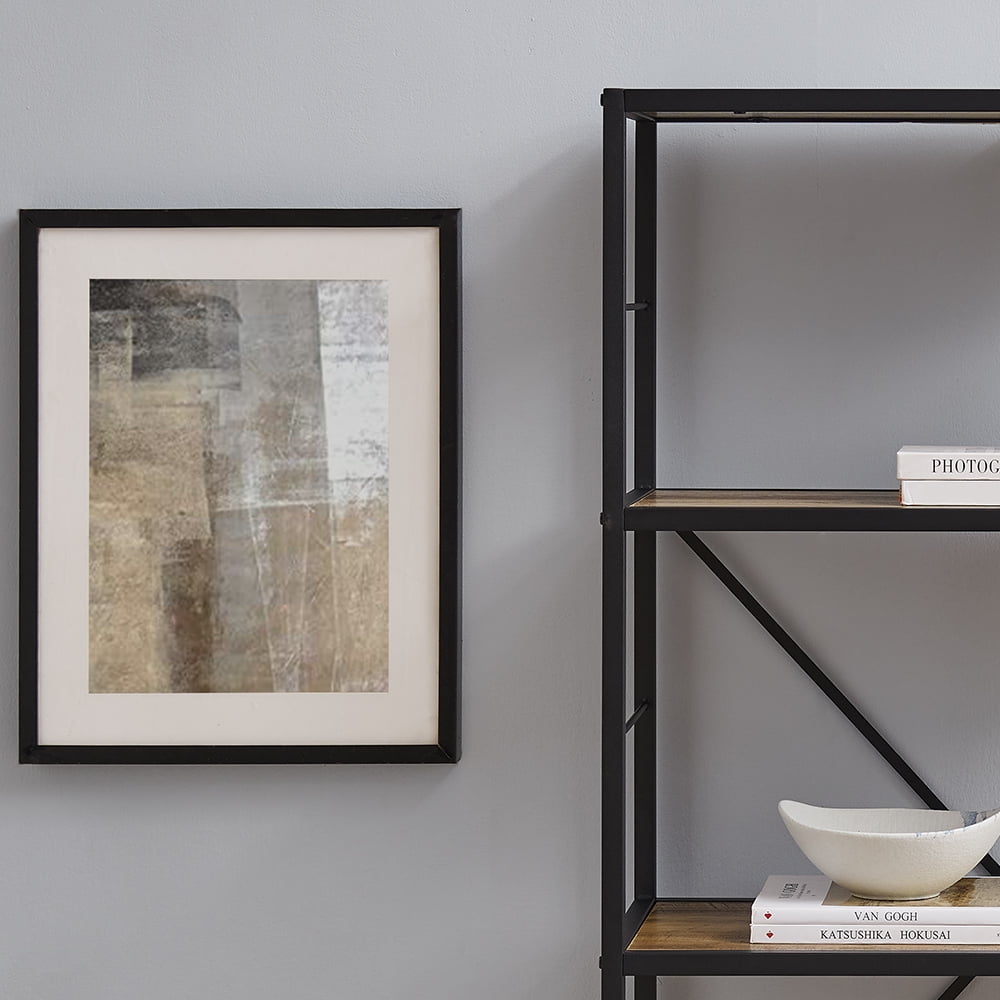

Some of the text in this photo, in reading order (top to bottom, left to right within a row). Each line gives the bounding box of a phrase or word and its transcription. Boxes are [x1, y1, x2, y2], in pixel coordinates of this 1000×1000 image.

[854, 911, 918, 921] VAN GOGH
[820, 929, 951, 940] KATSUSHIKA HOKUSAI
